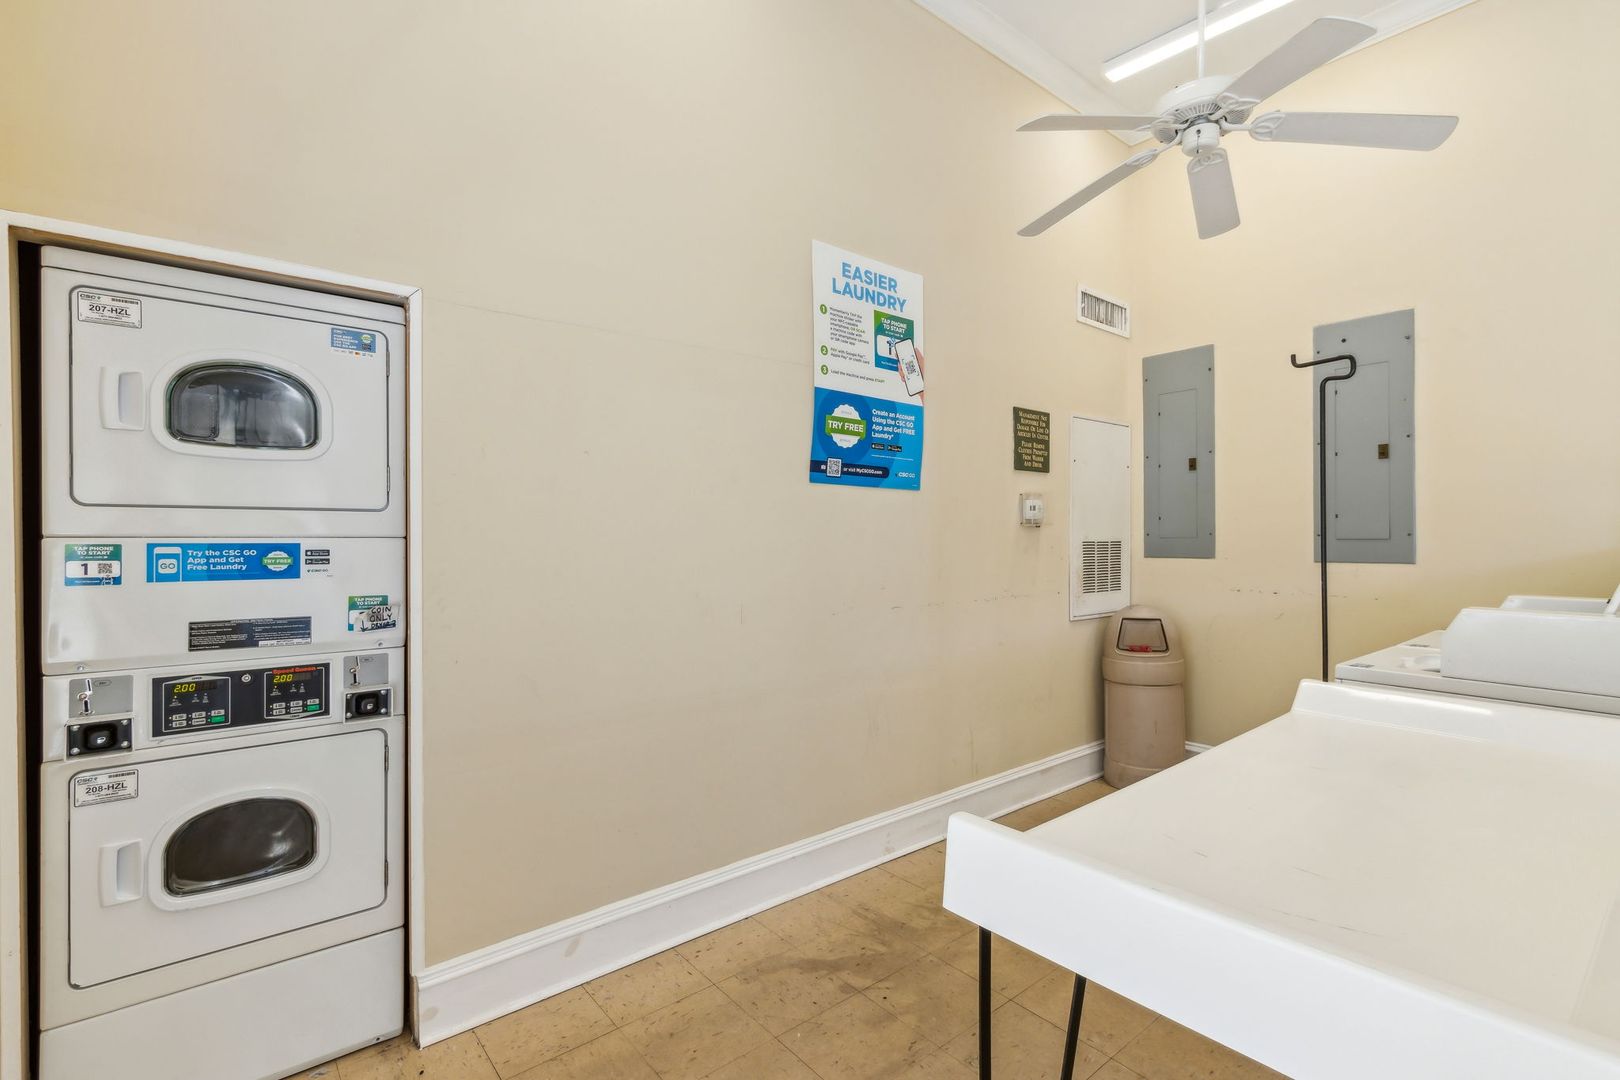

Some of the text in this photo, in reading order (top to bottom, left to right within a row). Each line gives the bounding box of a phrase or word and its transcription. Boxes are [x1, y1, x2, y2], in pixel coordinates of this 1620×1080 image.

[842, 262, 898, 294] EASIER
[832, 277, 907, 313] LAUNDRY
[89, 304, 131, 316] 207-HZL
[890, 320, 908, 330] PHONE
[890, 325, 906, 334] START
[871, 408, 915, 421] Create an Account
[828, 420, 864, 433] TRY FREE
[871, 416, 887, 425] Using
[906, 421, 915, 429] GO
[871, 424, 883, 433] App
[902, 428, 916, 436] FREE
[187, 549, 203, 557] Try
[80, 562, 89, 576] 1
[159, 562, 176, 570] GO
[210, 563, 248, 571] Laundry
[371, 605, 393, 615] COIN
[369, 612, 393, 623] ONLY
[274, 673, 293, 683] 2.00
[174, 683, 196, 693] 2.00
[85, 782, 128, 794] 208-HZL
